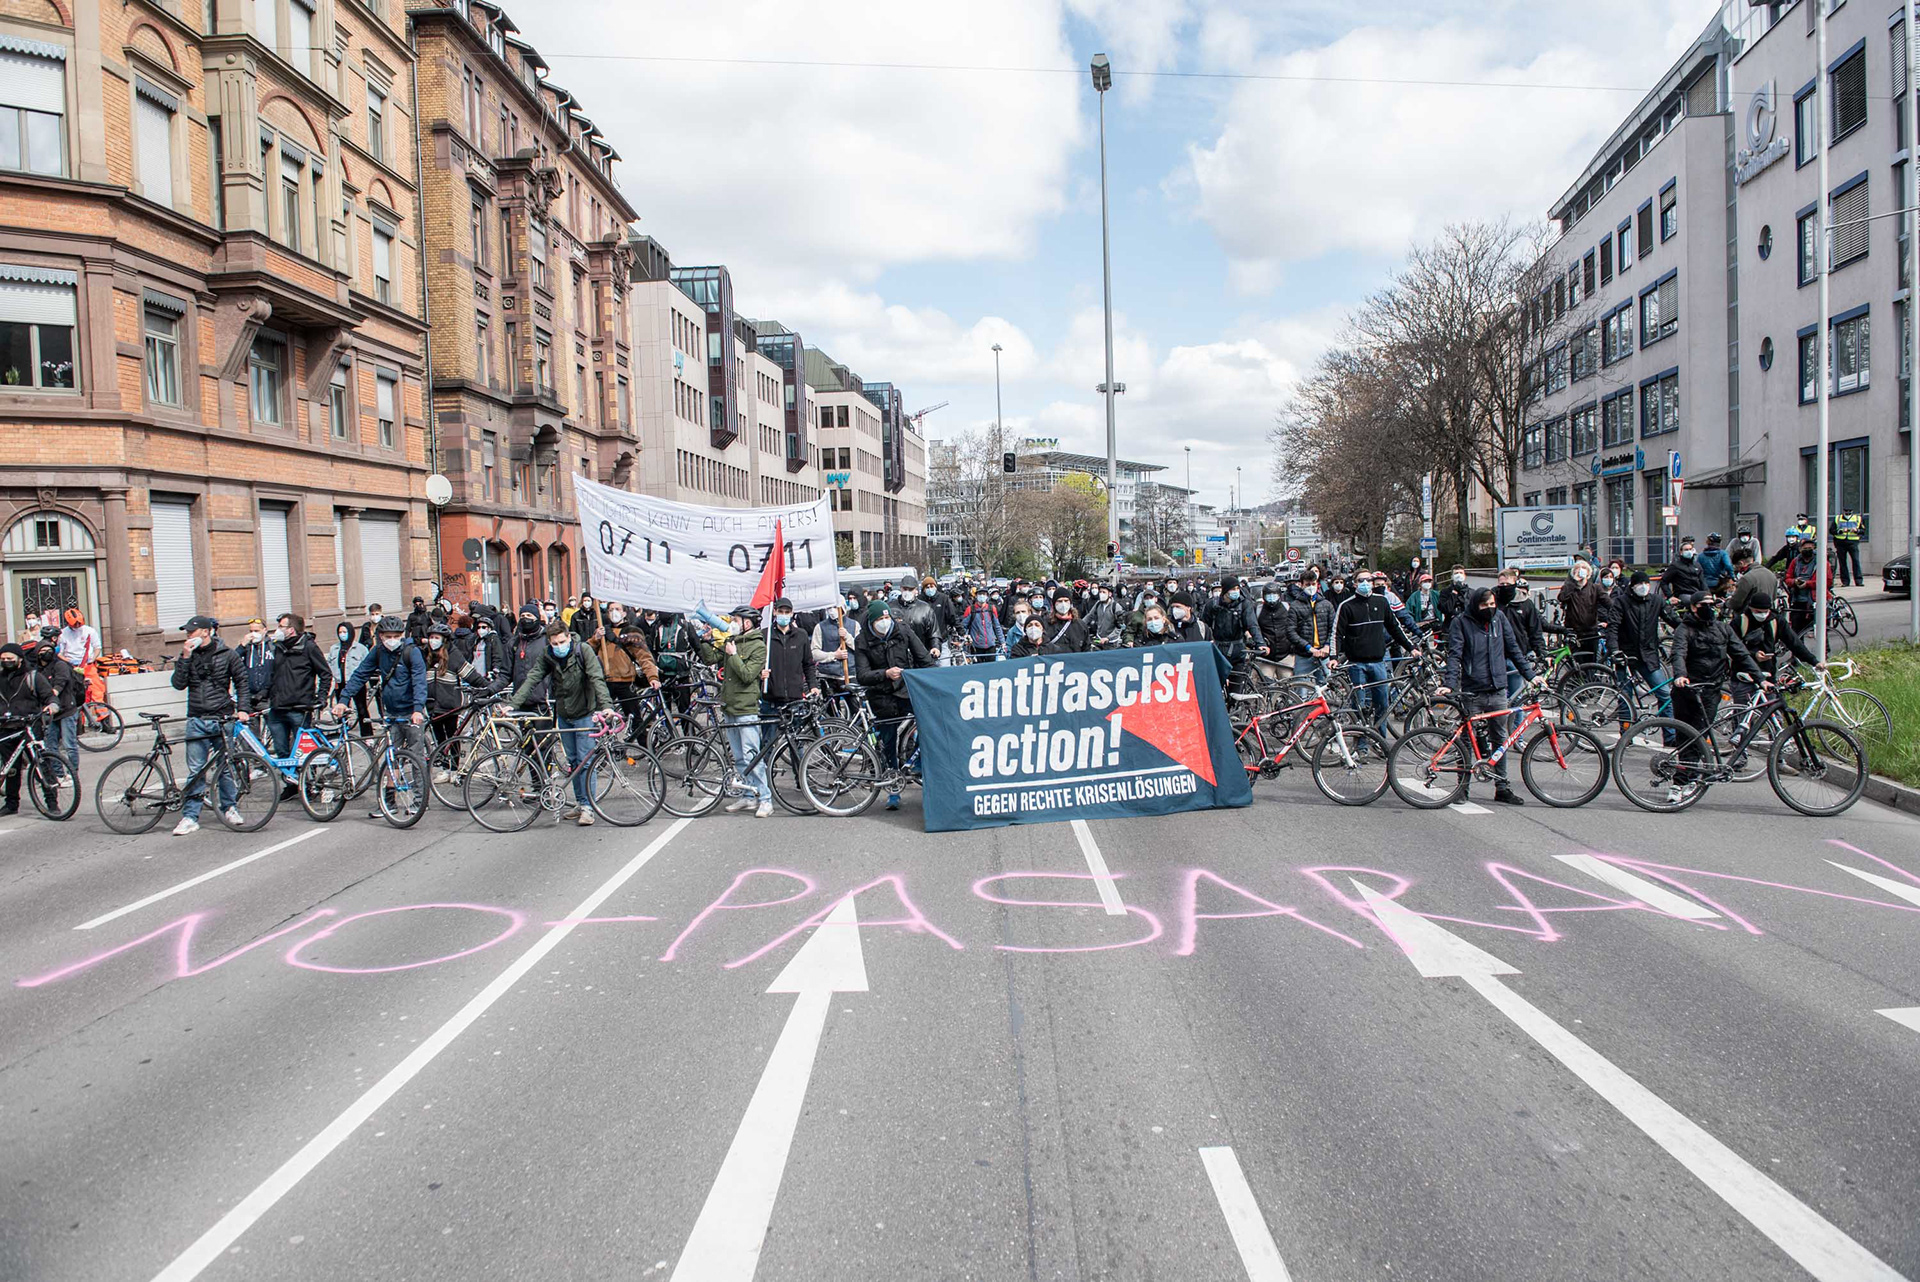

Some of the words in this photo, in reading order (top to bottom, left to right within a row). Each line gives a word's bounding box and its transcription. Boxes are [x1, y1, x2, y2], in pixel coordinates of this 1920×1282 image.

[826, 472, 851, 488] wgv
[647, 509, 691, 530] KANN
[702, 516, 742, 532] AUCH
[758, 507, 817, 531] ANDERS!
[1516, 534, 1567, 543] Continentale
[599, 520, 671, 565] 0711
[728, 538, 813, 573] 0711
[593, 565, 629, 592] NEIN
[644, 576, 667, 598] ZU
[682, 578, 819, 604] QUERDEN!
[959, 652, 1194, 721] antifascist
[968, 713, 1123, 778] action!
[973, 791, 1018, 816] GEGEN
[1020, 788, 1073, 812] RECHTE
[1074, 774, 1197, 806] KRISENLÖSUNGEN
